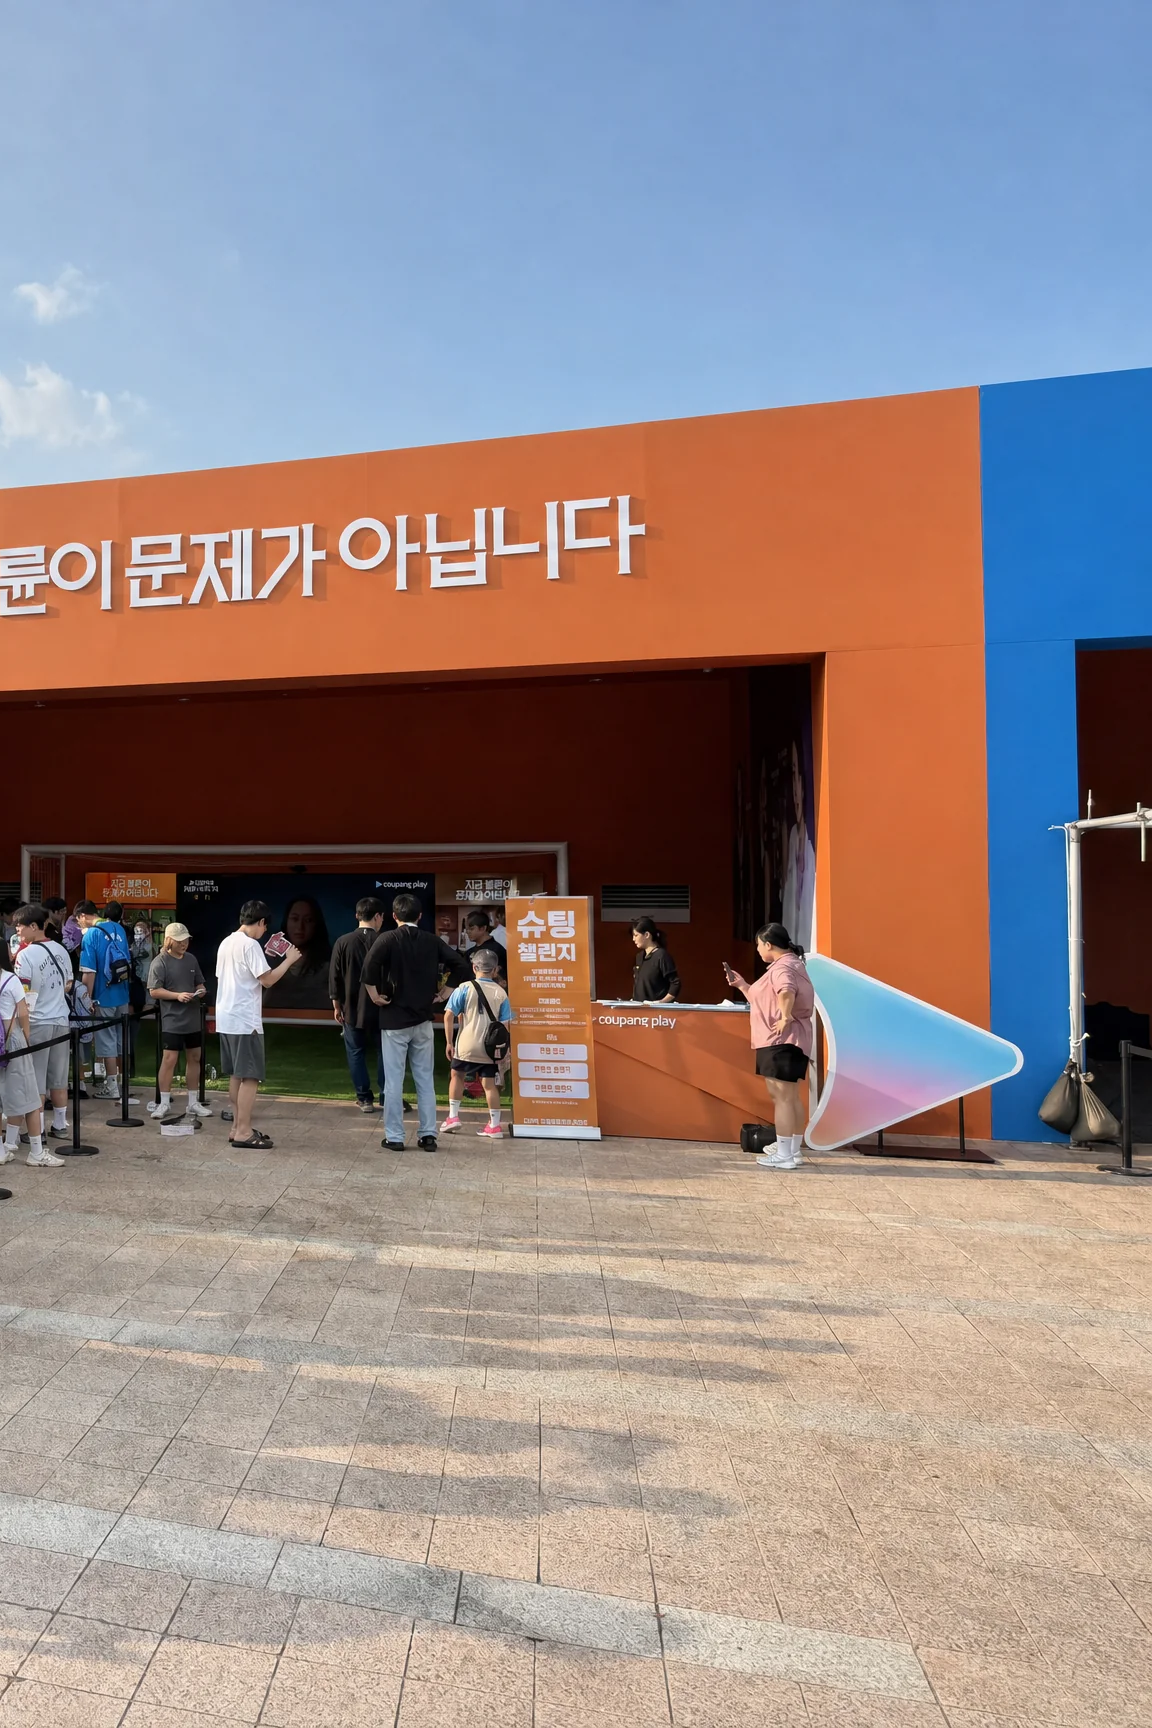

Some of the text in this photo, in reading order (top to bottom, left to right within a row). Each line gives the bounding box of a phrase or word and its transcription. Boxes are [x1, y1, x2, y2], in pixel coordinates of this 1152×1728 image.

[125, 523, 326, 608] 문제가
[338, 495, 645, 590] 아닙니다
[383, 880, 428, 889] coupang play
[517, 910, 576, 939] 슈팅
[518, 943, 576, 962] 챌린지
[598, 1015, 676, 1029] coupang play
